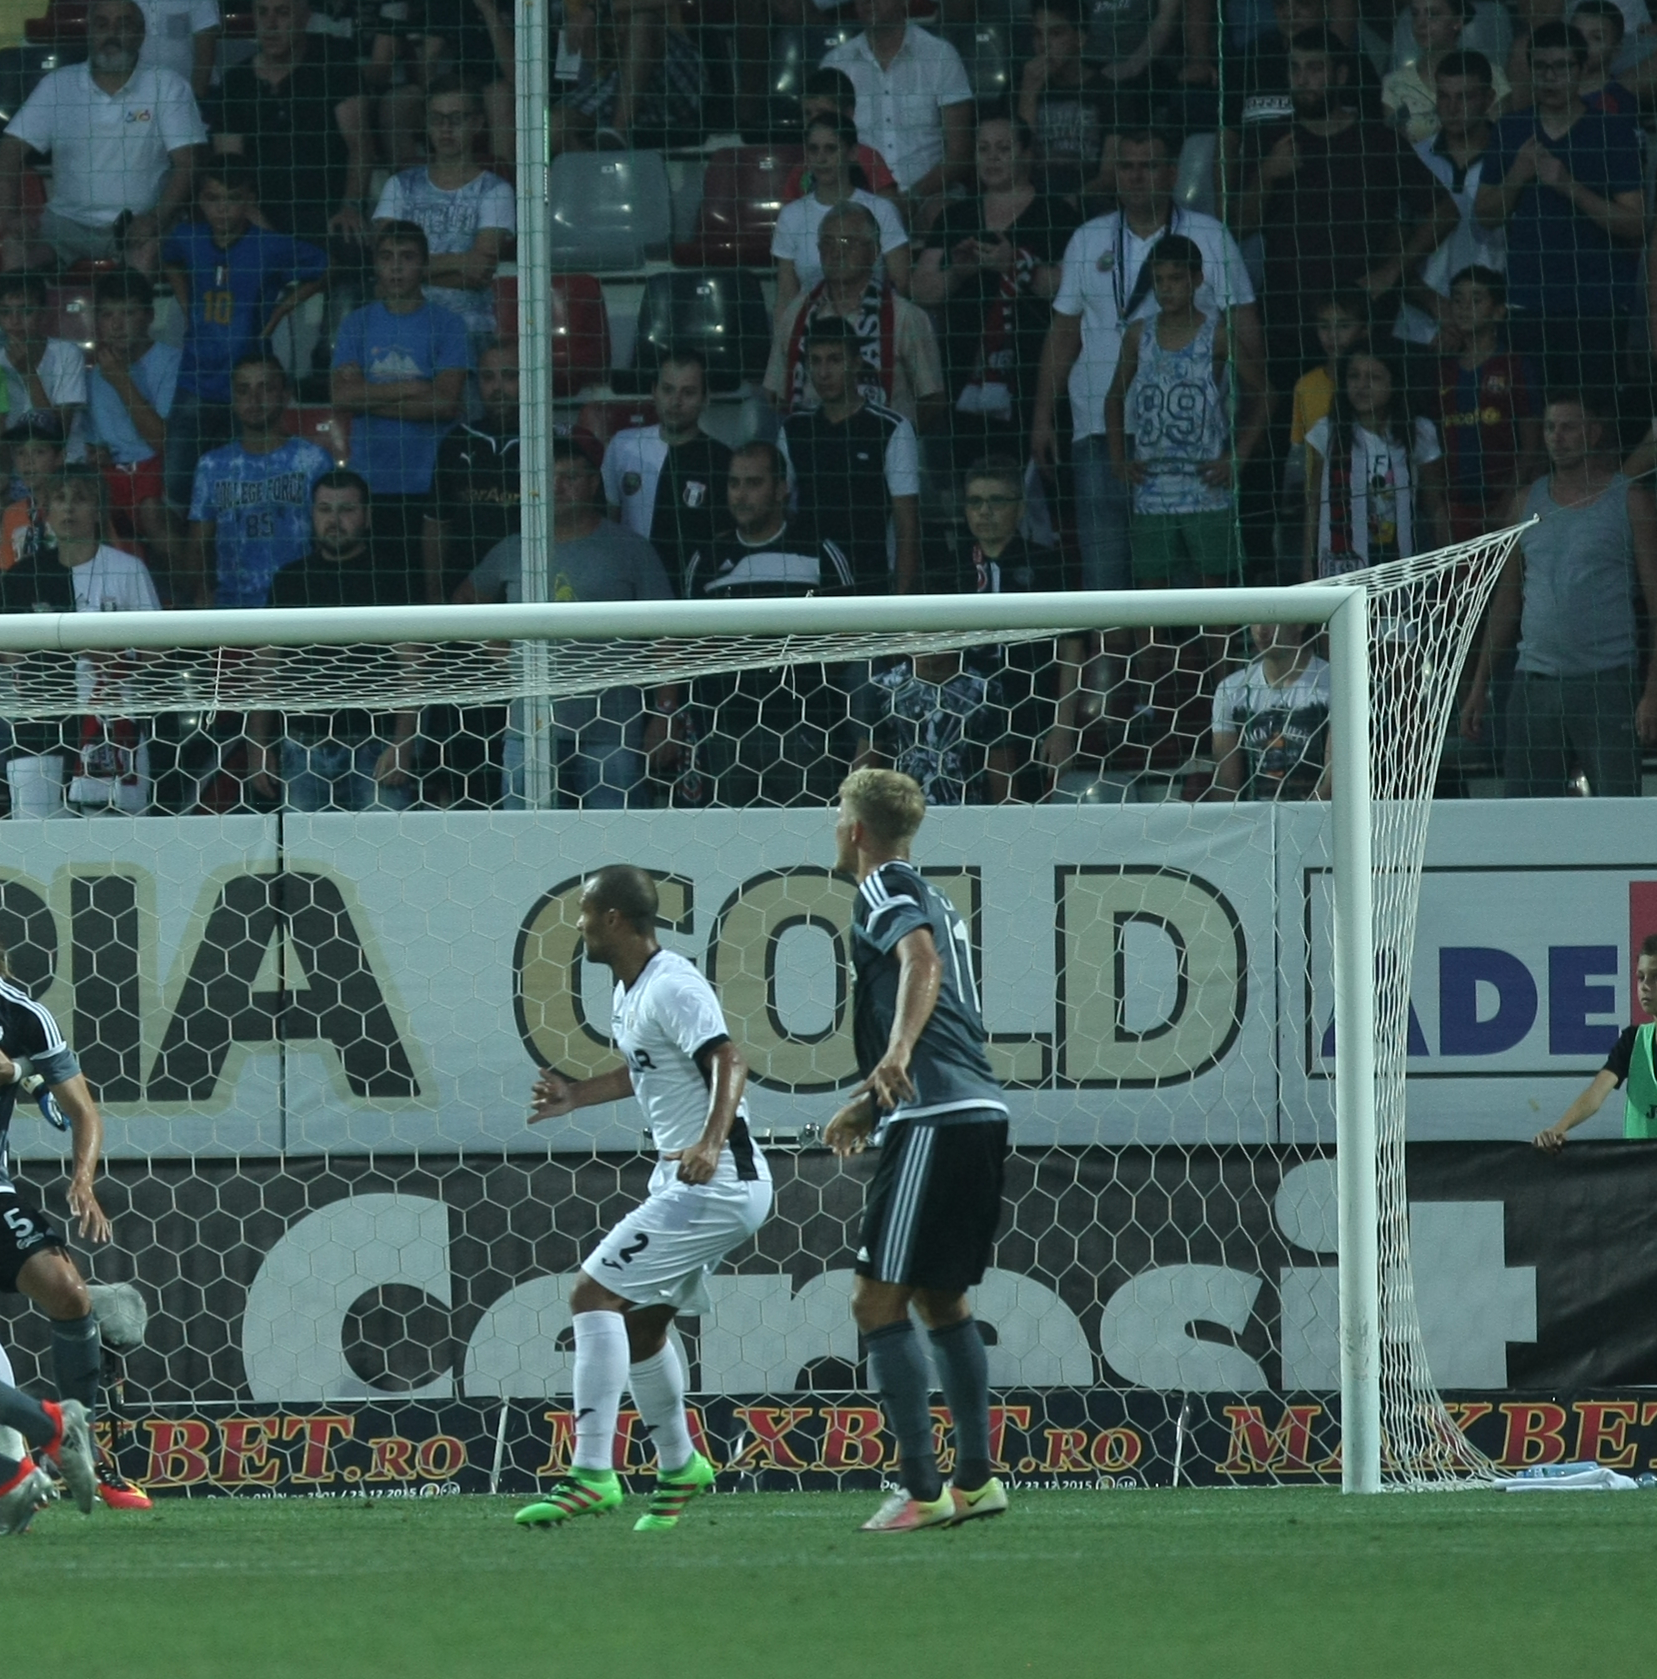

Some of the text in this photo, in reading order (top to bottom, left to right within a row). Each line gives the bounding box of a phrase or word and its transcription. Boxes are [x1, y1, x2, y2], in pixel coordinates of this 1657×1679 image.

[203, 289, 232, 324] 10
[3, 1207, 34, 1238] 5
[619, 1233, 649, 1264] 2
